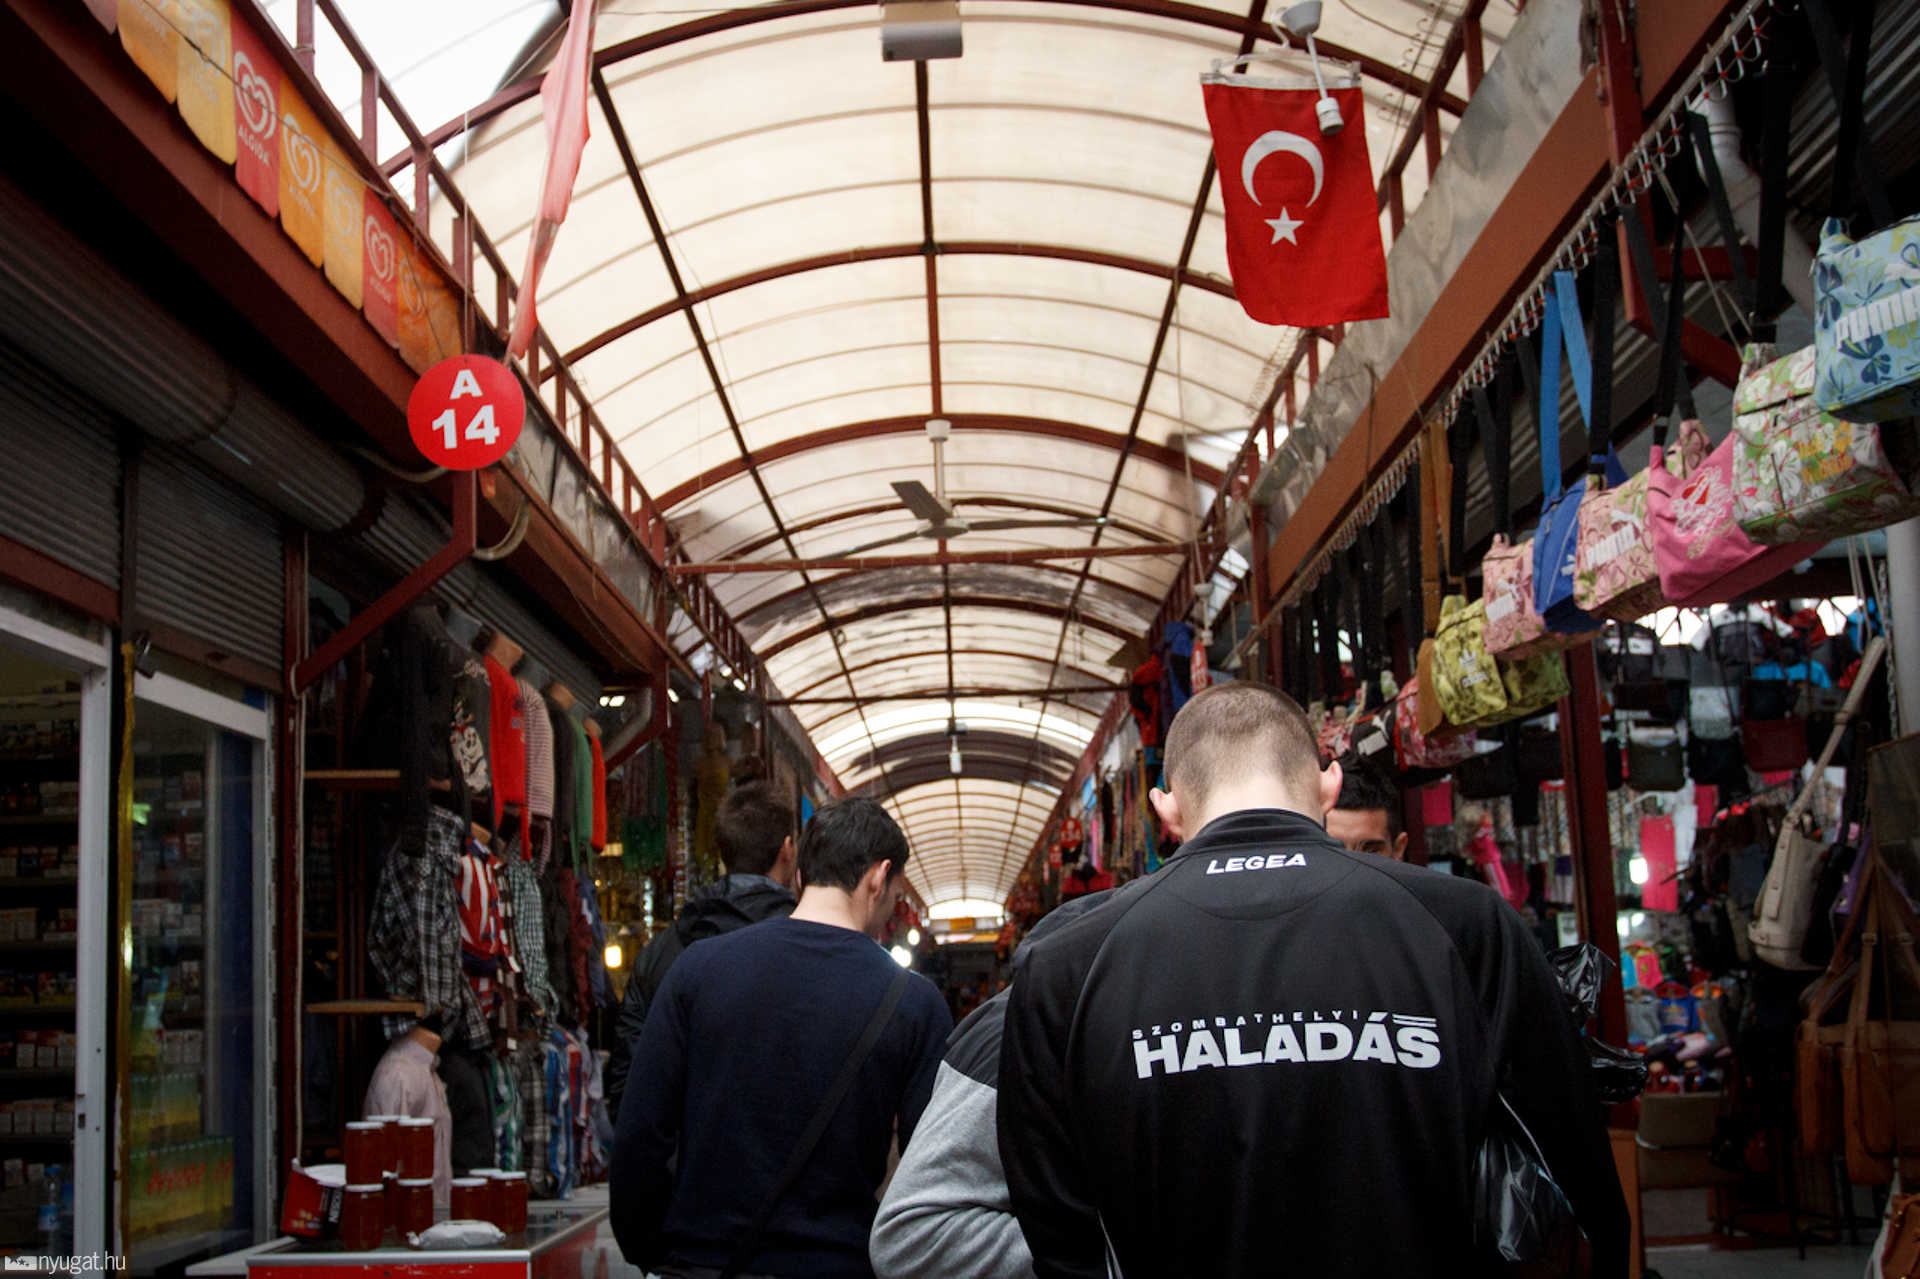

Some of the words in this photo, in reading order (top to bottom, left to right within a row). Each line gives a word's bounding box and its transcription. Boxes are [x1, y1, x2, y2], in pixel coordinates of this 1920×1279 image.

[449, 368, 483, 400] A
[431, 404, 500, 450] 14
[1206, 853, 1307, 875] LEGEA
[1132, 1010, 1360, 1040] SZOMBATHELYI
[1132, 1012, 1442, 1080] HALADÁS
